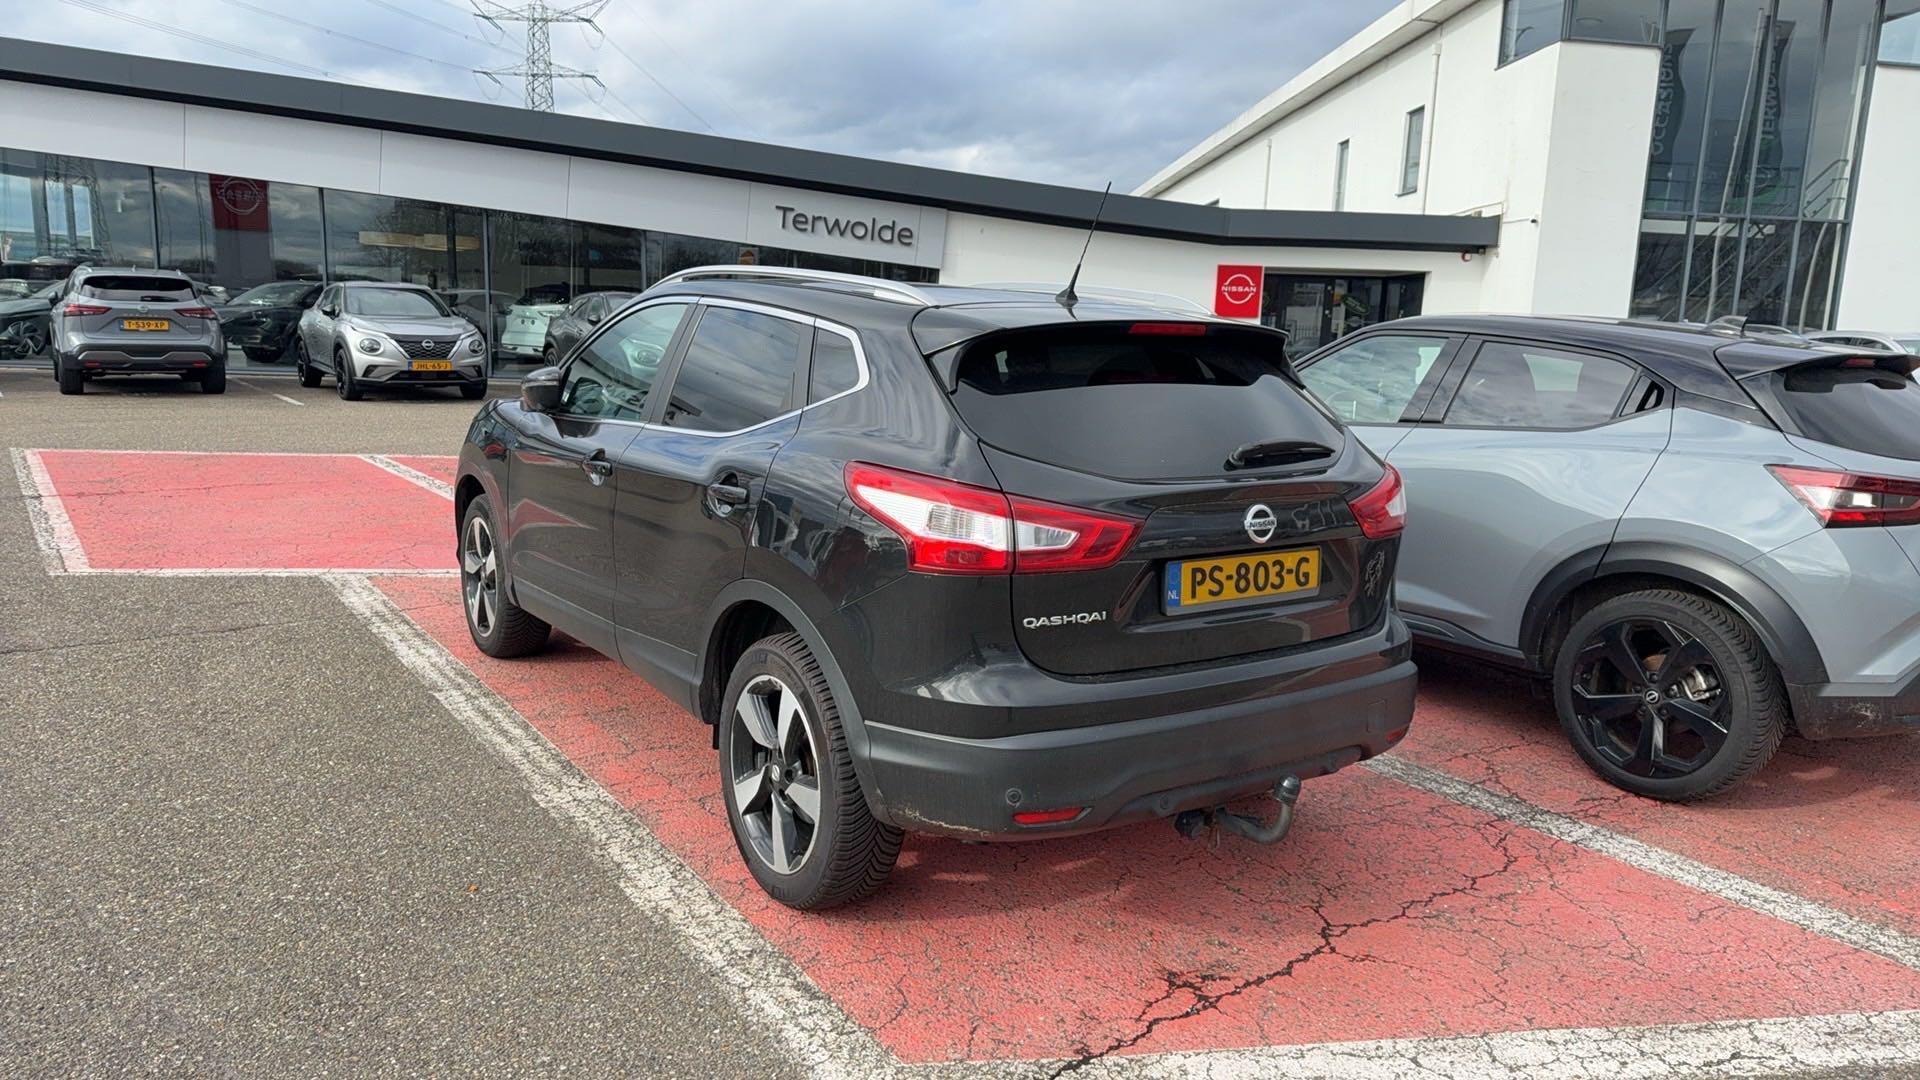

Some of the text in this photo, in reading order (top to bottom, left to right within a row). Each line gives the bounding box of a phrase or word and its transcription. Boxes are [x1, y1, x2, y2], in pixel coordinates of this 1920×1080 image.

[775, 205, 914, 246] Terwolde
[127, 321, 165, 329] T-539-XP
[1250, 518, 1275, 529] NISSAN
[1167, 556, 1310, 600] NL PS-803-G
[1023, 611, 1107, 629] QASHQAI
